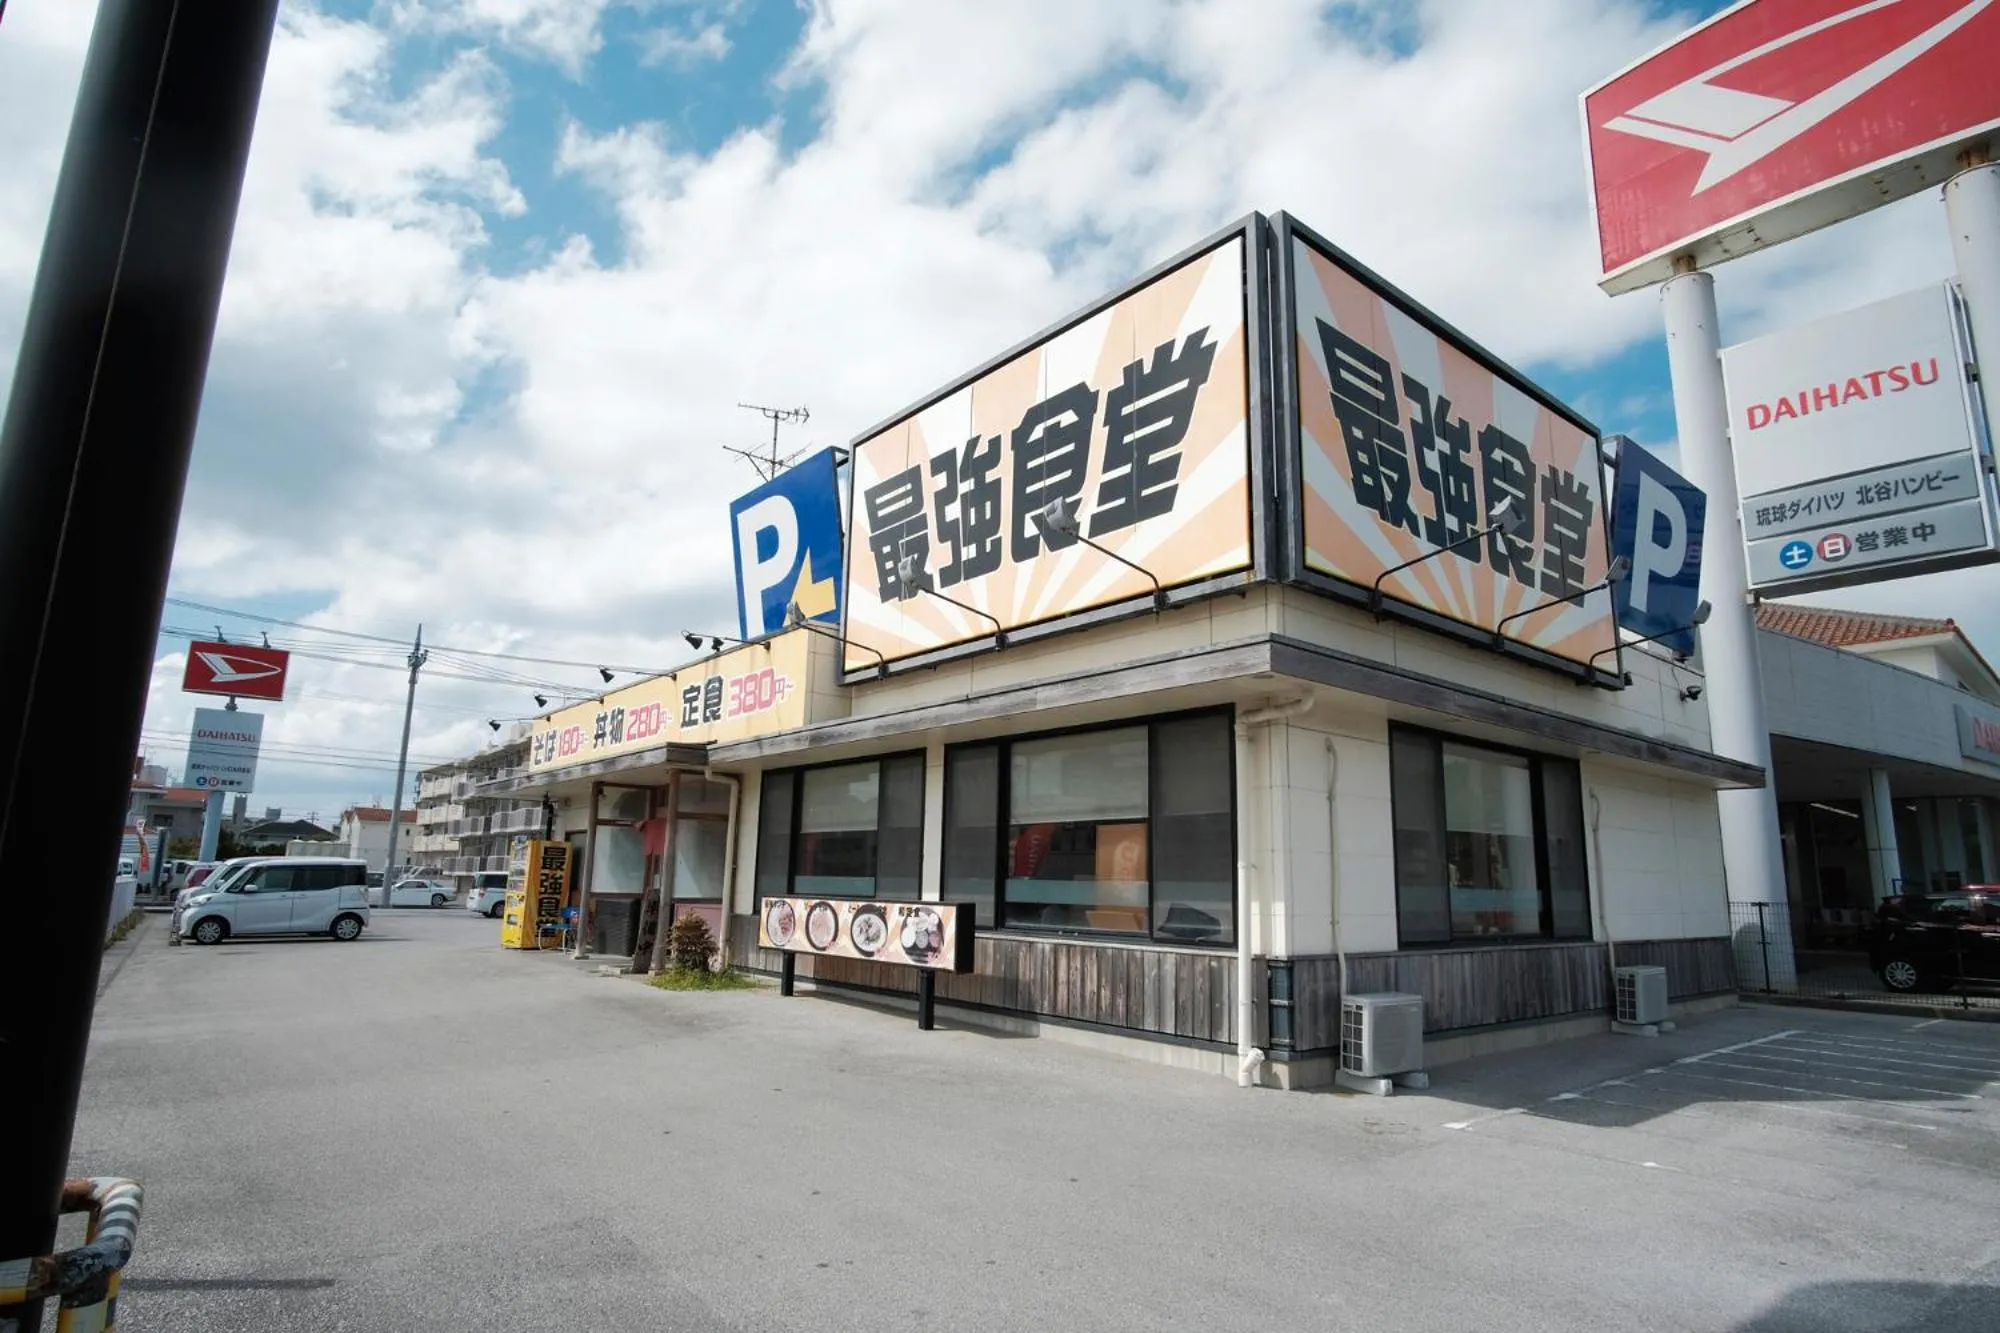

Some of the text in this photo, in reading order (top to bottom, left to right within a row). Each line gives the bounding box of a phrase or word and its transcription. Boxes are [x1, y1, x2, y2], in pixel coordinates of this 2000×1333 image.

[864, 325, 1218, 603] 最強食堂
[1315, 317, 1594, 608] 最強食堂
[1746, 358, 1939, 430] DAIHATSU
[737, 495, 798, 639] P
[1629, 470, 1687, 613] P
[1756, 470, 1960, 527] 琉球ダイハツ 北谷ハンビー
